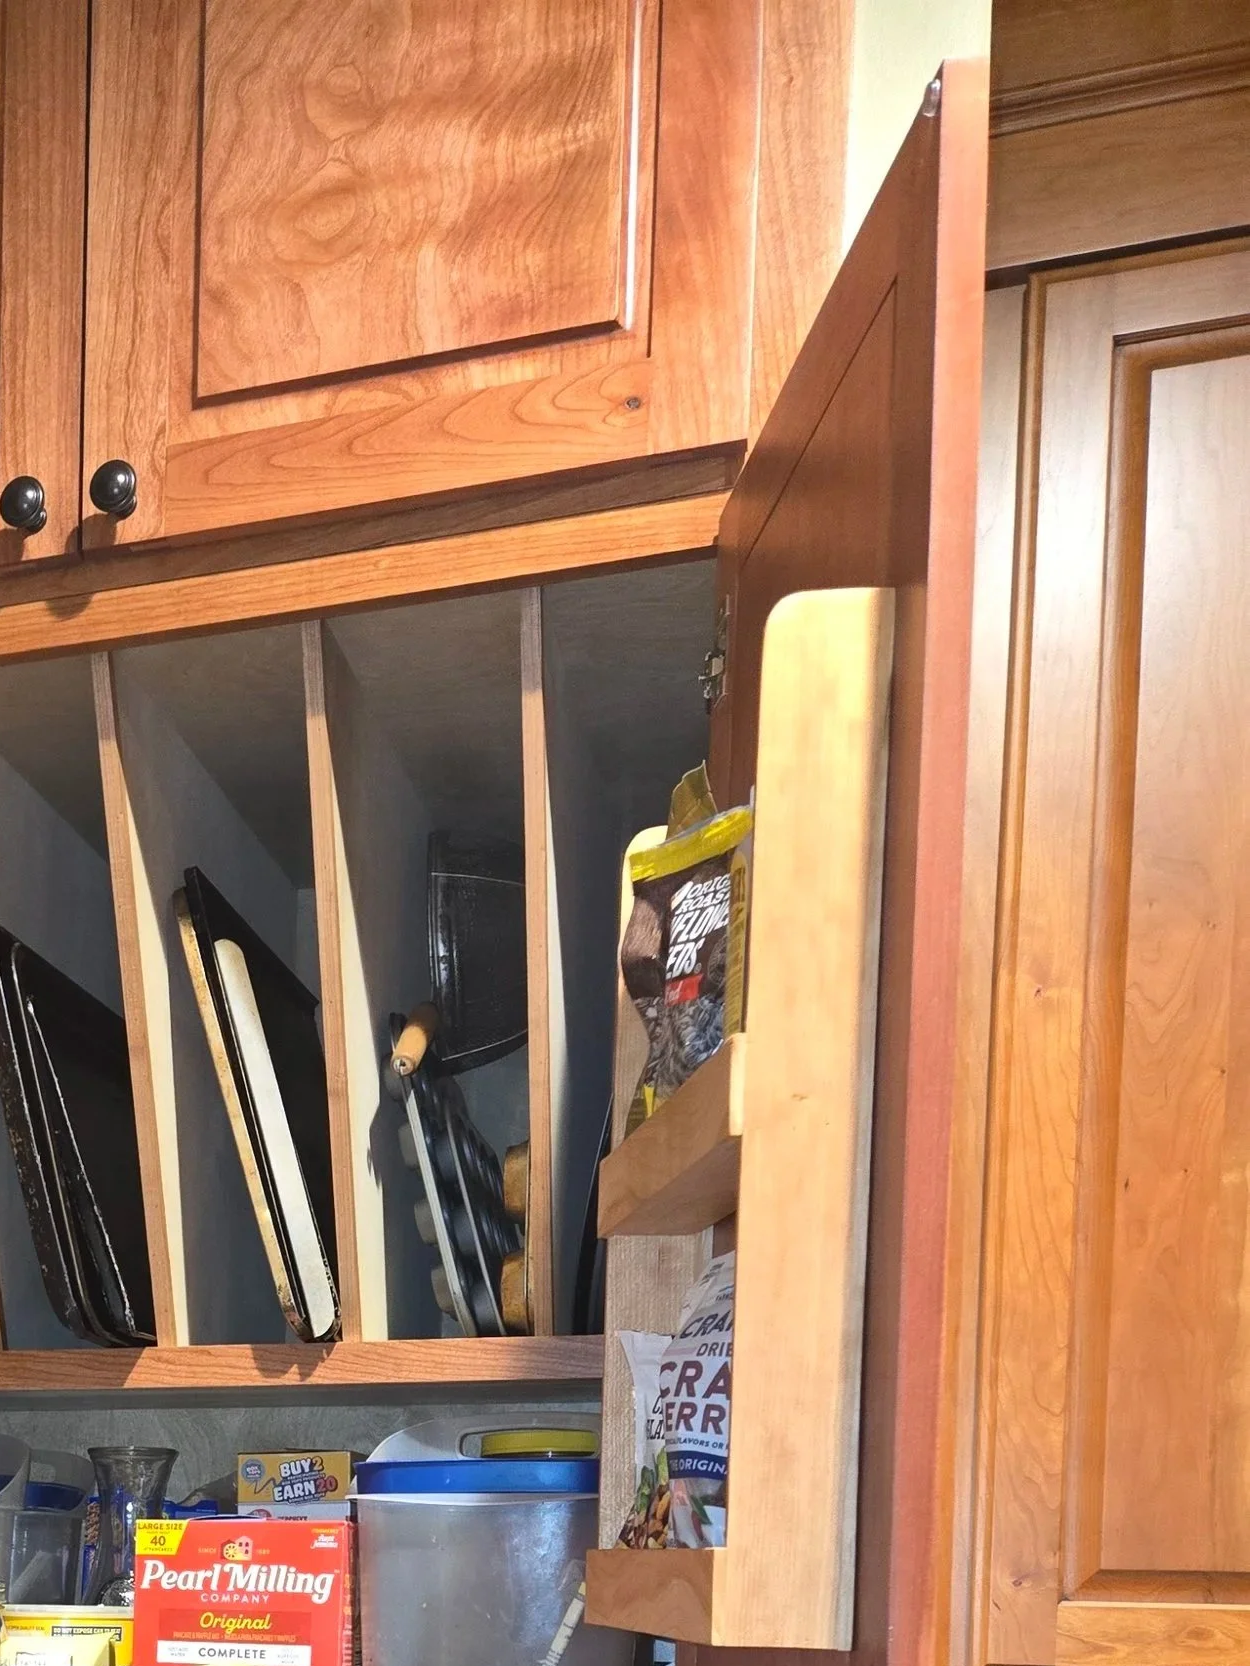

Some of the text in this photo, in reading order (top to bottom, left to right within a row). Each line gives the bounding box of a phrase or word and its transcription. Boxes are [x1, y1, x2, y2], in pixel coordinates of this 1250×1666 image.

[280, 1456, 324, 1477] BUY 2
[273, 1475, 338, 1501] EARN 20
[137, 1523, 164, 1531] LARGE
[150, 1535, 166, 1546] 40
[140, 1559, 335, 1604] Pearl Milling
[200, 1593, 269, 1604] COMPANY
[200, 1611, 272, 1634] Original
[198, 1647, 267, 1660] COMPLETE
